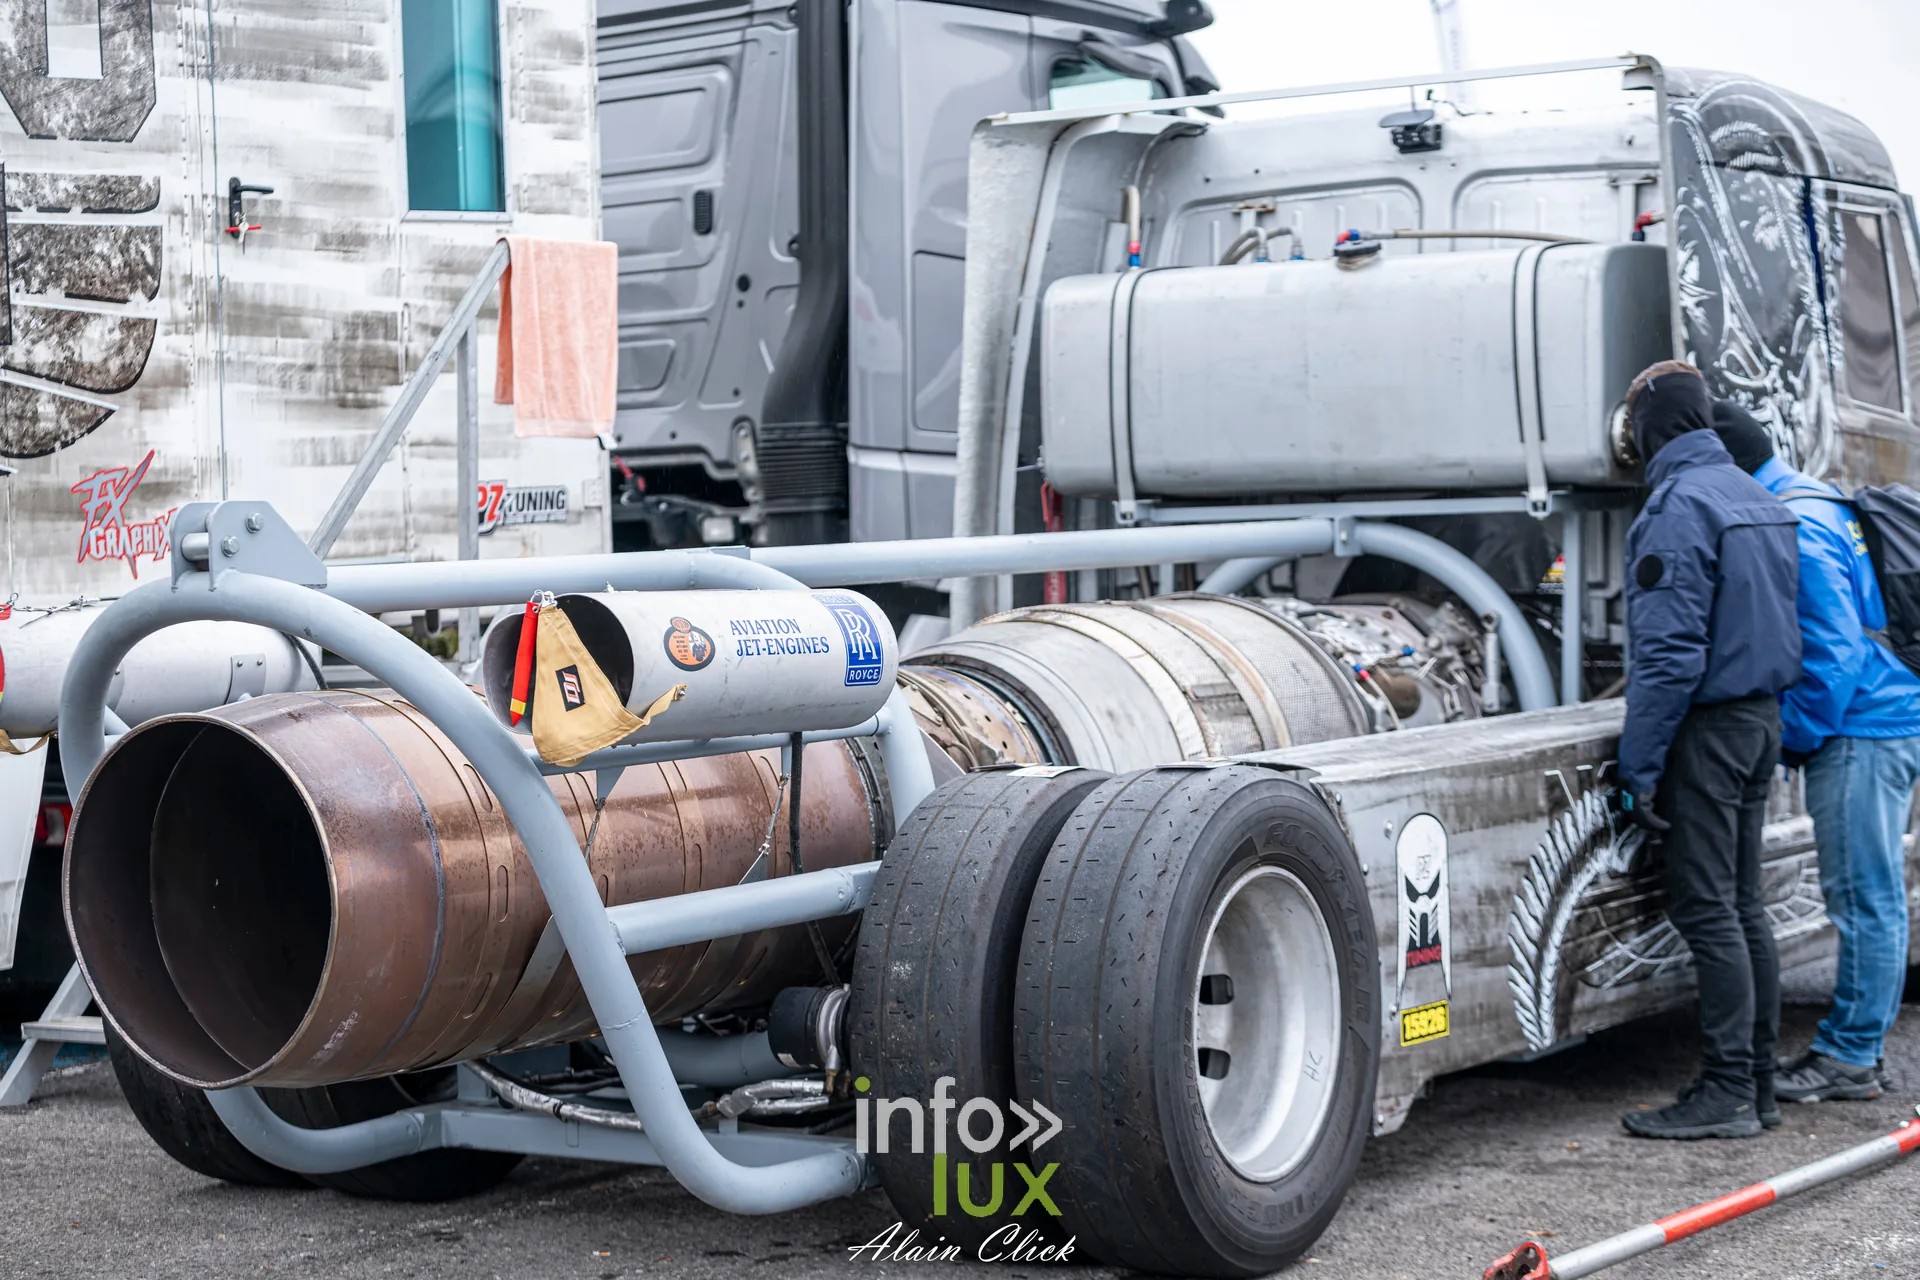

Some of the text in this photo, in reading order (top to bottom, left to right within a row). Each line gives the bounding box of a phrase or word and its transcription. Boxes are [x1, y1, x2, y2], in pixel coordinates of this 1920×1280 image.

[505, 489, 565, 513] TUNING
[729, 618, 802, 636] AVIATION
[736, 636, 830, 657] JET-ENGINES
[848, 669, 879, 681] ROYCE
[1262, 821, 1371, 1026] GOODYEAR
[1406, 944, 1442, 968] TUNING
[1403, 1005, 1447, 1041] 15926
